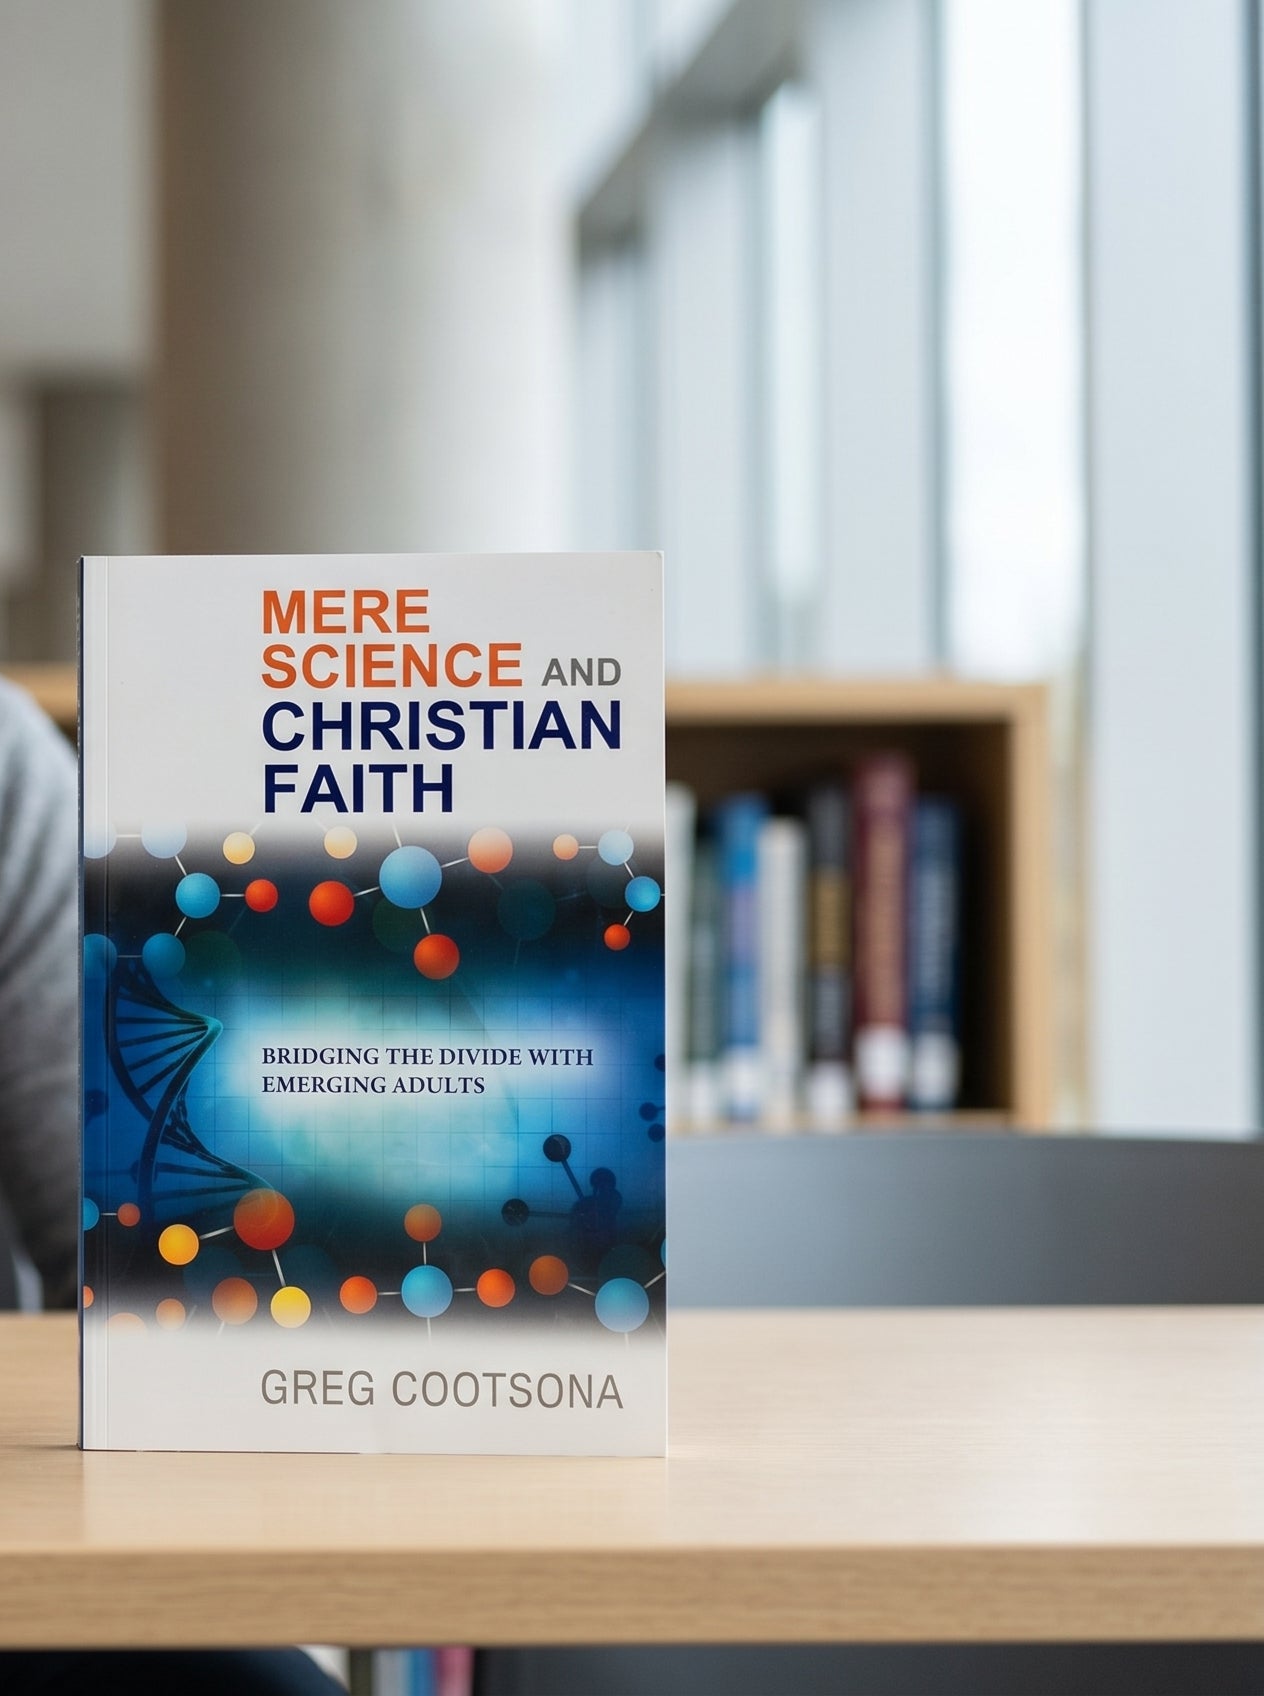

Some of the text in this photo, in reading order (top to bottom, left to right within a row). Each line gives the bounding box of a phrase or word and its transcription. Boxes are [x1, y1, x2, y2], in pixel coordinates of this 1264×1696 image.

[262, 588, 430, 635] MERE
[261, 642, 622, 690] SCIENCE AND
[262, 699, 621, 752] CHRISTIAN
[264, 763, 453, 814] FAITH
[261, 1047, 594, 1066] BRIDGING THE DIVIDE WITH
[261, 1076, 485, 1094] EMERGING ADULTS
[261, 1369, 624, 1409] GREG COOTSONA
